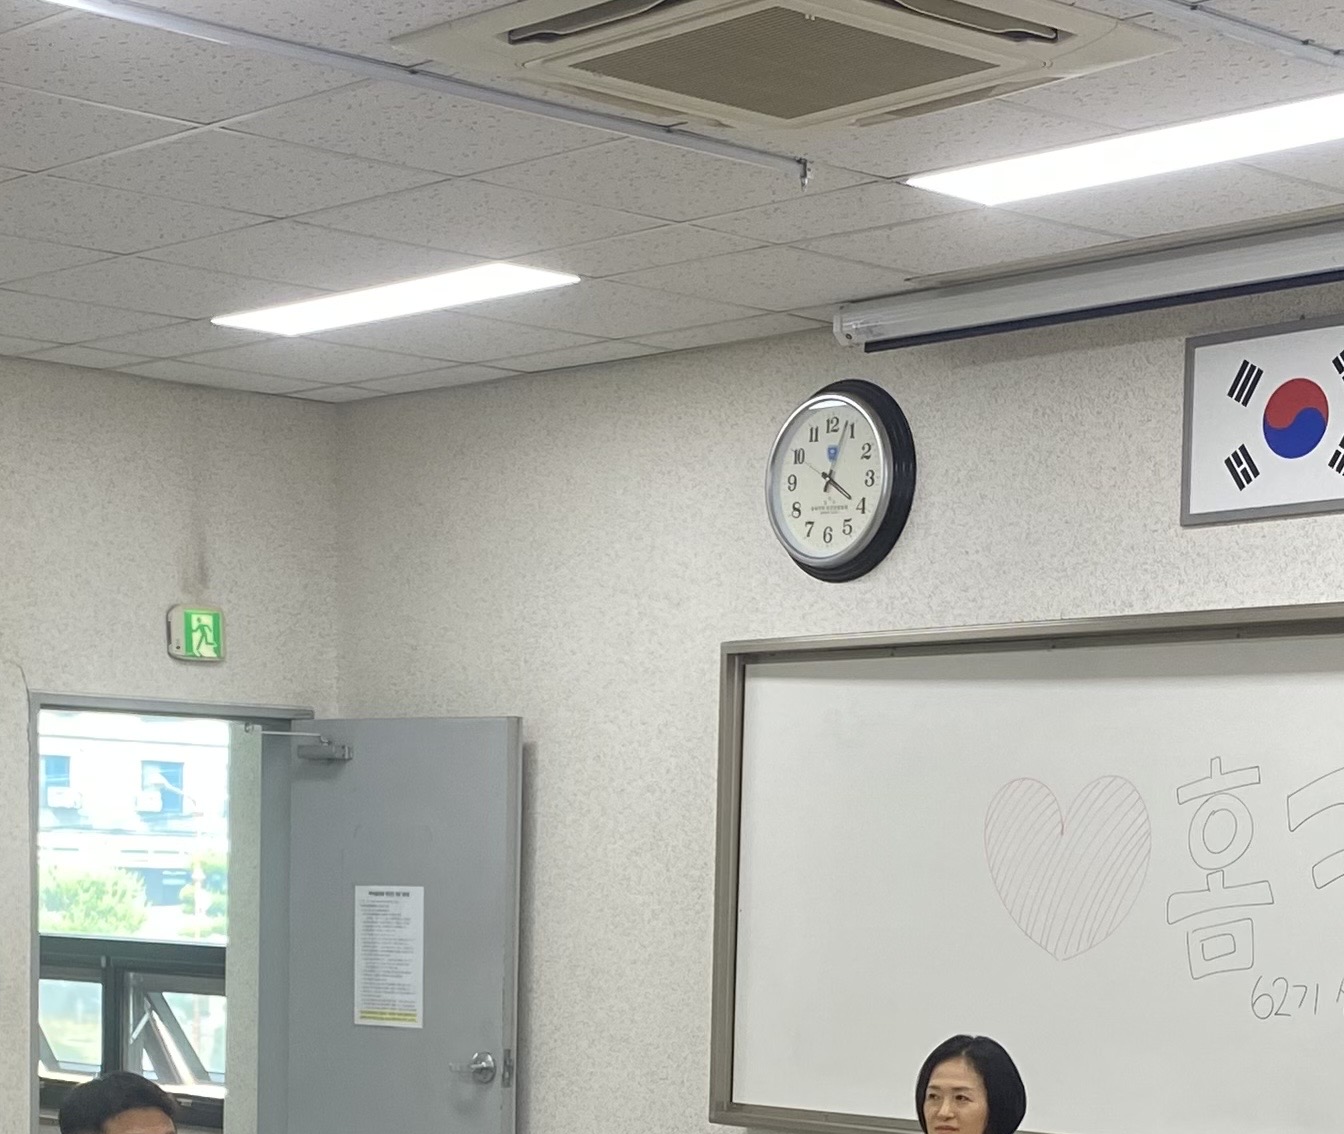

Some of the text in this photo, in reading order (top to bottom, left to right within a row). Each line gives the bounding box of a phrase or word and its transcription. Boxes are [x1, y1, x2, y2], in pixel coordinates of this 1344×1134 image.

[826, 416, 840, 433] 12
[808, 427, 819, 442] 11
[793, 448, 805, 465] 10
[860, 442, 872, 460] 2
[787, 474, 798, 492] 9
[864, 469, 876, 487] 3
[791, 501, 802, 519] 8
[856, 497, 866, 515] 4
[804, 521, 815, 538] 7
[822, 526, 833, 544] 6
[842, 518, 853, 535] 5
[1251, 976, 1319, 1020] 62기
